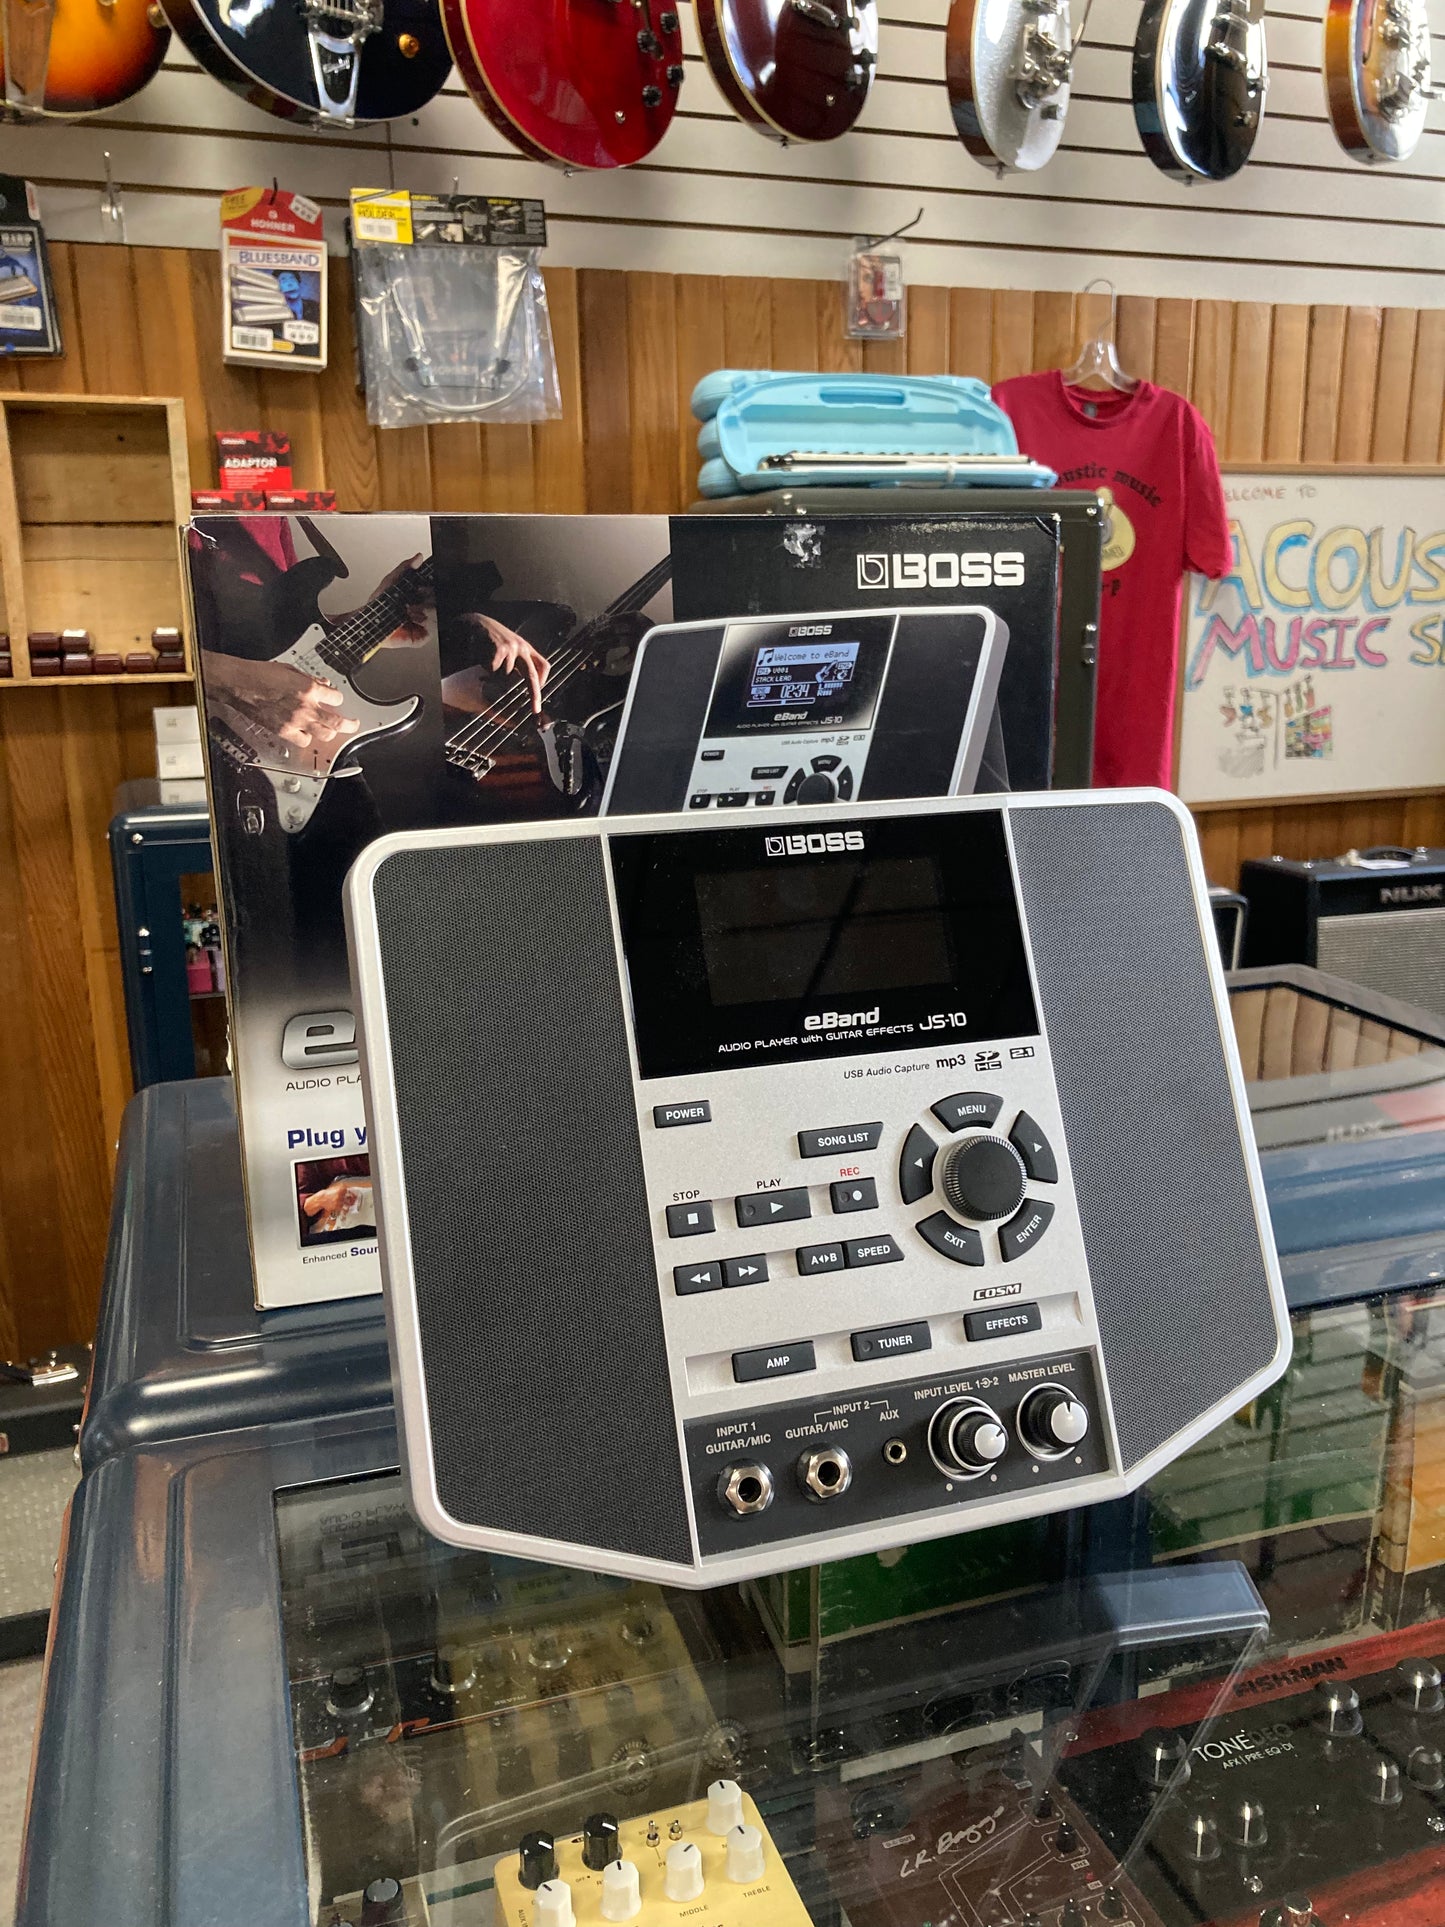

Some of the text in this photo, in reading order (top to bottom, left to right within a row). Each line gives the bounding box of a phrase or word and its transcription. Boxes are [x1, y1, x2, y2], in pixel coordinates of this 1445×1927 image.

[251, 219, 295, 233] HOHNER
[239, 251, 319, 266] BLUESBAND
[224, 457, 278, 469] ADAPTOR
[1222, 486, 1287, 502] ELCOME
[893, 552, 1025, 588] BOSS
[798, 625, 832, 637] BOSS
[775, 650, 850, 660] Welcome to eBand
[1191, 613, 1445, 692] MUSIC S
[775, 675, 792, 683] LEAD
[781, 684, 810, 698] 02:34
[774, 711, 808, 721] eBand
[820, 716, 843, 725] JS-10
[821, 736, 835, 744] mp3
[785, 830, 866, 856] BOSS
[804, 1007, 880, 1031] eBand
[919, 1012, 967, 1031] JS-10
[281, 1010, 359, 1070] e
[718, 1023, 914, 1054] AUDIO PLAYER with GUITAR EFFECTS
[844, 1053, 966, 1080] USB Audio Capture mp3
[286, 1075, 363, 1092] AUDIO PLA
[666, 1107, 704, 1121] POWER
[957, 1105, 987, 1117] MENU
[287, 1126, 368, 1149] Plug y
[818, 1132, 869, 1147] SONG LIST
[840, 1167, 860, 1177] REC
[756, 1178, 781, 1189] PLAY
[672, 1189, 700, 1201] STOP
[1016, 1214, 1043, 1244] ENTER
[943, 1231, 966, 1249] EXIT
[302, 1251, 347, 1265] Enhanced
[857, 1244, 891, 1258] SPEED
[974, 1283, 1021, 1300] COSM
[986, 1316, 1029, 1331] EFFECTS
[878, 1335, 913, 1349] TUNER
[766, 1356, 790, 1369] AMP
[1008, 1363, 1075, 1383] MASTER LEVEL
[914, 1386, 942, 1400] INPUT
[944, 1381, 973, 1396] LEVEL
[833, 1400, 870, 1416] INPUT 2
[879, 1409, 900, 1422] AUX
[716, 1422, 757, 1437] INPUT 1
[785, 1419, 849, 1439] GUITAR/MIC
[705, 1433, 772, 1455] GUITAR/MIC
[1233, 1657, 1348, 1697] FISHMAN
[743, 1885, 772, 1898] TREBLE
[679, 1904, 709, 1918] MIDDLE
